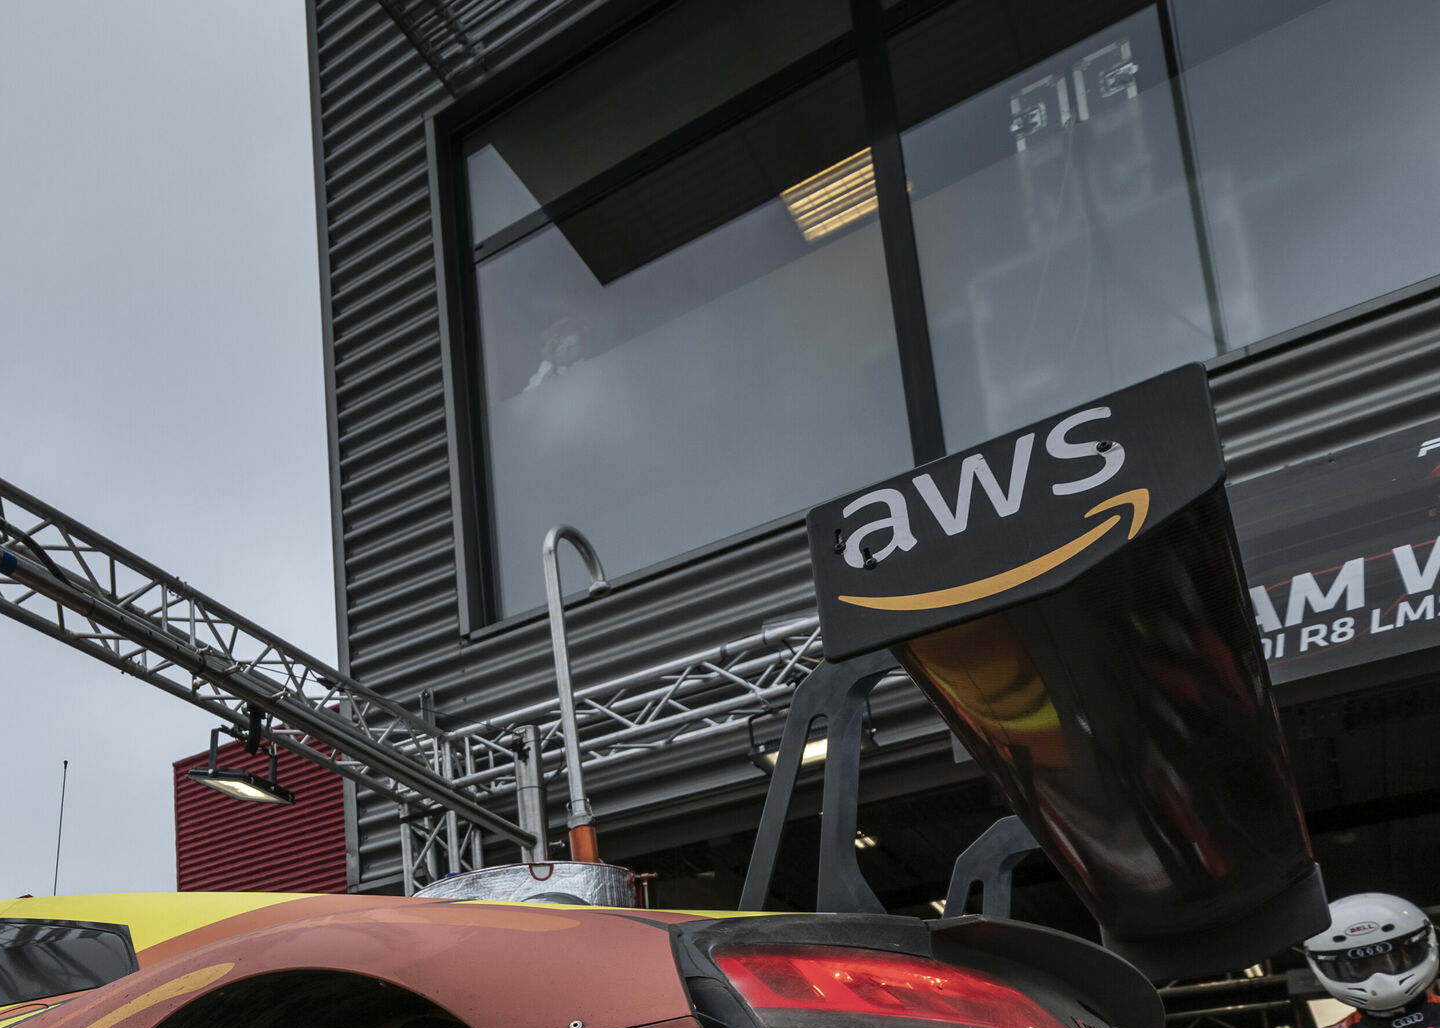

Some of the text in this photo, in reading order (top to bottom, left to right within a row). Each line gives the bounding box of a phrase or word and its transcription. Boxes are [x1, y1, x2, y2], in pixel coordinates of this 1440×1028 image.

[842, 406, 1126, 569] aws
[1299, 616, 1356, 652] R8
[1370, 594, 1440, 635] LM
[1349, 924, 1375, 933] BELL
